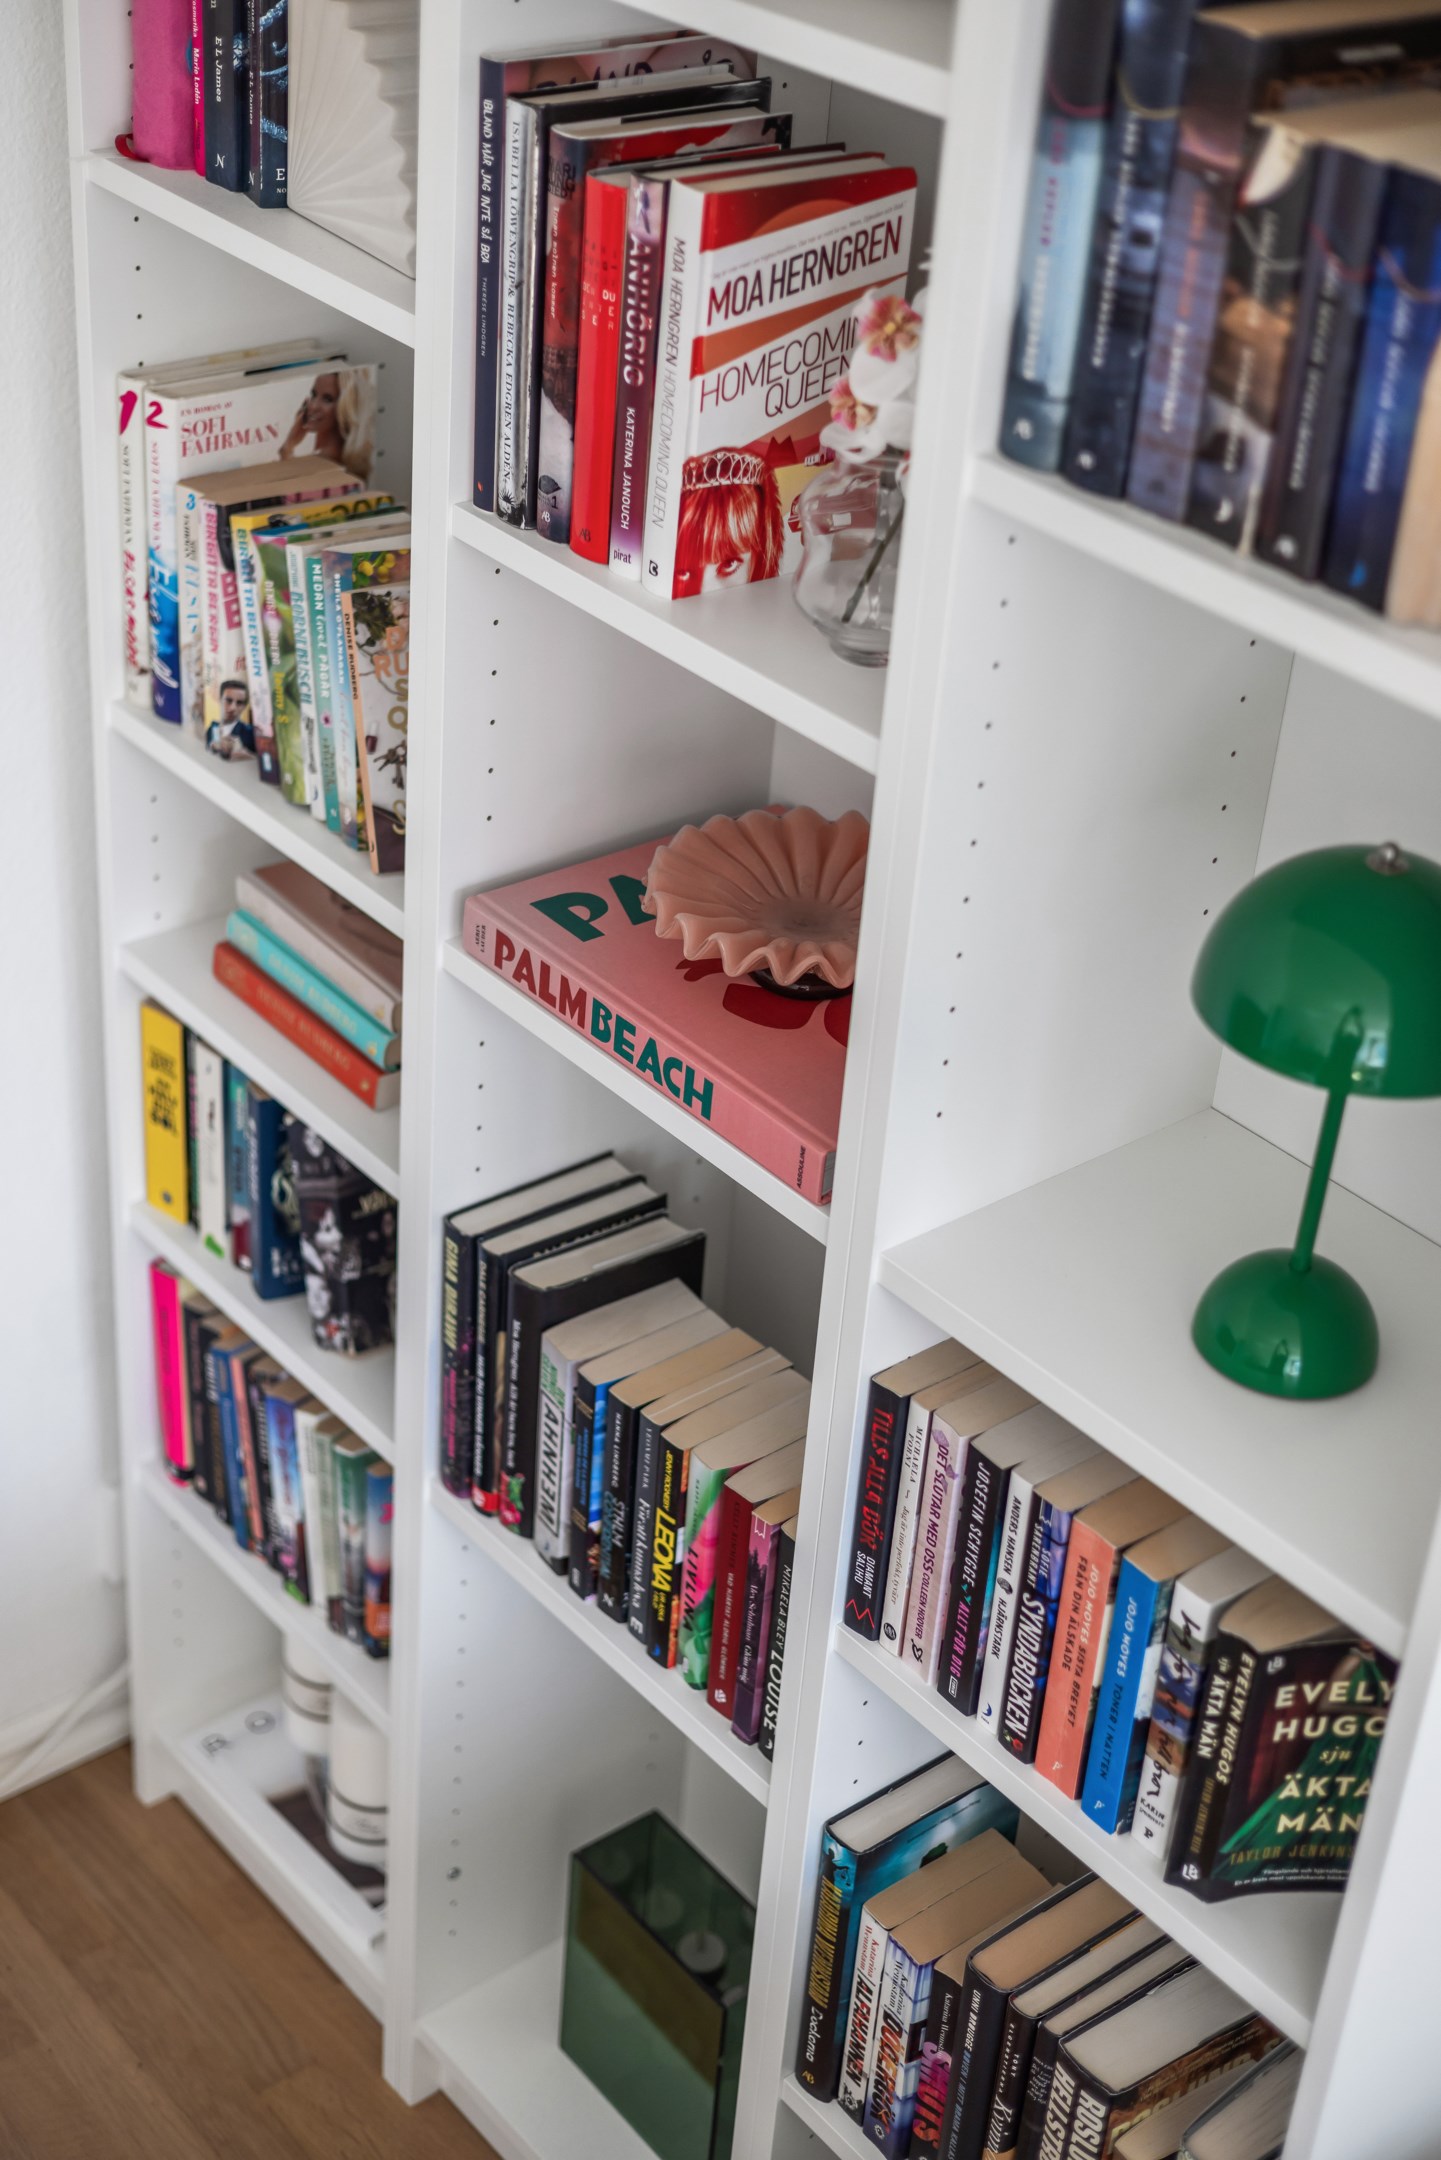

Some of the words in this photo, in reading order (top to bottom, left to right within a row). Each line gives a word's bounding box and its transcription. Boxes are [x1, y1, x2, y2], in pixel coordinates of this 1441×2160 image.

[482, 98, 493, 138] IBLAND
[481, 142, 493, 167] MÅR
[510, 120, 520, 191] ISABELLA
[480, 169, 491, 192] JAG
[480, 191, 490, 223] INTE
[480, 244, 490, 263] BRA
[481, 226, 492, 241] SÅ
[672, 236, 687, 274] MOA
[707, 270, 764, 327] MOA
[769, 215, 903, 303] HERNGREN
[506, 303, 515, 368] REBECKA
[665, 276, 684, 367] HERNGREN
[119, 390, 138, 436] 1
[145, 401, 169, 429] 2
[504, 371, 513, 428] EDGREN
[181, 416, 226, 440] SOFI
[623, 406, 636, 468] KATERINA
[657, 367, 678, 476] HOMECOMING
[186, 493, 196, 510] 3
[620, 471, 633, 530] JANOUCH
[652, 476, 667, 528] QUEEN
[613, 549, 632, 564] pirat
[312, 564, 324, 611] MEDAN
[333, 573, 342, 611] SHEILA
[344, 613, 354, 650] DENISE
[349, 653, 358, 700] RUDBERG
[494, 928, 586, 1030] PALM
[590, 997, 714, 1121] BEACH
[797, 1145, 806, 1189] ASSOULINE
[445, 1236, 458, 1283] GINA
[513, 1319, 521, 1339] Moa
[613, 1412, 622, 1448] HANNA
[611, 1448, 620, 1489] LINDBERG
[904, 1433, 915, 1468] FORNI
[910, 1426, 923, 1483] MICHAELA
[936, 1445, 949, 1470] DET
[900, 1506, 910, 1520] Jag
[929, 1470, 946, 1519] SLUTAR
[971, 1462, 991, 1525] JOSEFIN
[611, 1498, 626, 1548] STHLM
[926, 1518, 939, 1548] MED
[1009, 1496, 1022, 1536] ANDERS
[651, 1506, 676, 1592] LEONA
[854, 1550, 866, 1585] SALIHU
[923, 1548, 936, 1574] OSS
[962, 1523, 982, 1588] SCHYGGE
[1003, 1535, 1016, 1576] HANSEN
[1027, 1522, 1043, 1589] SARENBRANT
[1038, 1547, 1051, 1579] SOFIE
[682, 1546, 698, 1632] LIVLINA
[778, 1564, 792, 1616] MIKAELA
[862, 1556, 876, 1599] DIAMANT
[919, 1573, 931, 1608] COLLEEN
[1075, 1555, 1088, 1590] FRÅN
[1086, 1564, 1099, 1599] JOJO
[914, 1606, 927, 1640] HOOVER
[957, 1601, 970, 1632] ALLT
[1071, 1591, 1082, 1615] DIN
[1079, 1599, 1095, 1645] MOYES
[1125, 1596, 1139, 1632] JOJO
[774, 1618, 785, 1650] BLEY
[954, 1630, 967, 1656] FÖR
[990, 1597, 1007, 1659] HJÄRNSTARK
[1062, 1616, 1080, 1672] ÄLSKADE
[950, 1654, 961, 1678] DIG
[1004, 1592, 1045, 1740] SYNDABOCKEN
[1073, 1645, 1087, 1678] SISTA
[1116, 1632, 1134, 1678] MOYES
[1218, 1657, 1231, 1673] sju
[1067, 1680, 1081, 1728] BREVET
[1108, 1682, 1123, 1725] TONER
[1206, 1675, 1229, 1717] ÄKTA
[1230, 1652, 1255, 1722] EVELYN
[1099, 1732, 1114, 1781] NATTEN
[1197, 1720, 1219, 1760] MÄN
[1216, 1722, 1239, 1786] HUGOS
[1319, 1746, 1352, 1764] sju
[1140, 1797, 1165, 1821] KARIN
[1230, 1846, 1282, 1866] TAYLOR
[860, 1924, 874, 1972] Wennstam
[868, 1938, 880, 1978] Katarina
[888, 1960, 904, 2008] Wennstam
[896, 1973, 909, 2016] Katarina
[972, 1989, 982, 2013] UNNI
[941, 1993, 954, 2023] Katarina
[845, 1975, 874, 2088] ALFAHANNEN
[964, 2012, 978, 2051] DROUGGE
[1010, 2053, 1020, 2078] TONY
[914, 2042, 953, 2151] SMUTS
[956, 2083, 966, 2105] MITT
[952, 2103, 963, 2132] DRAMA
